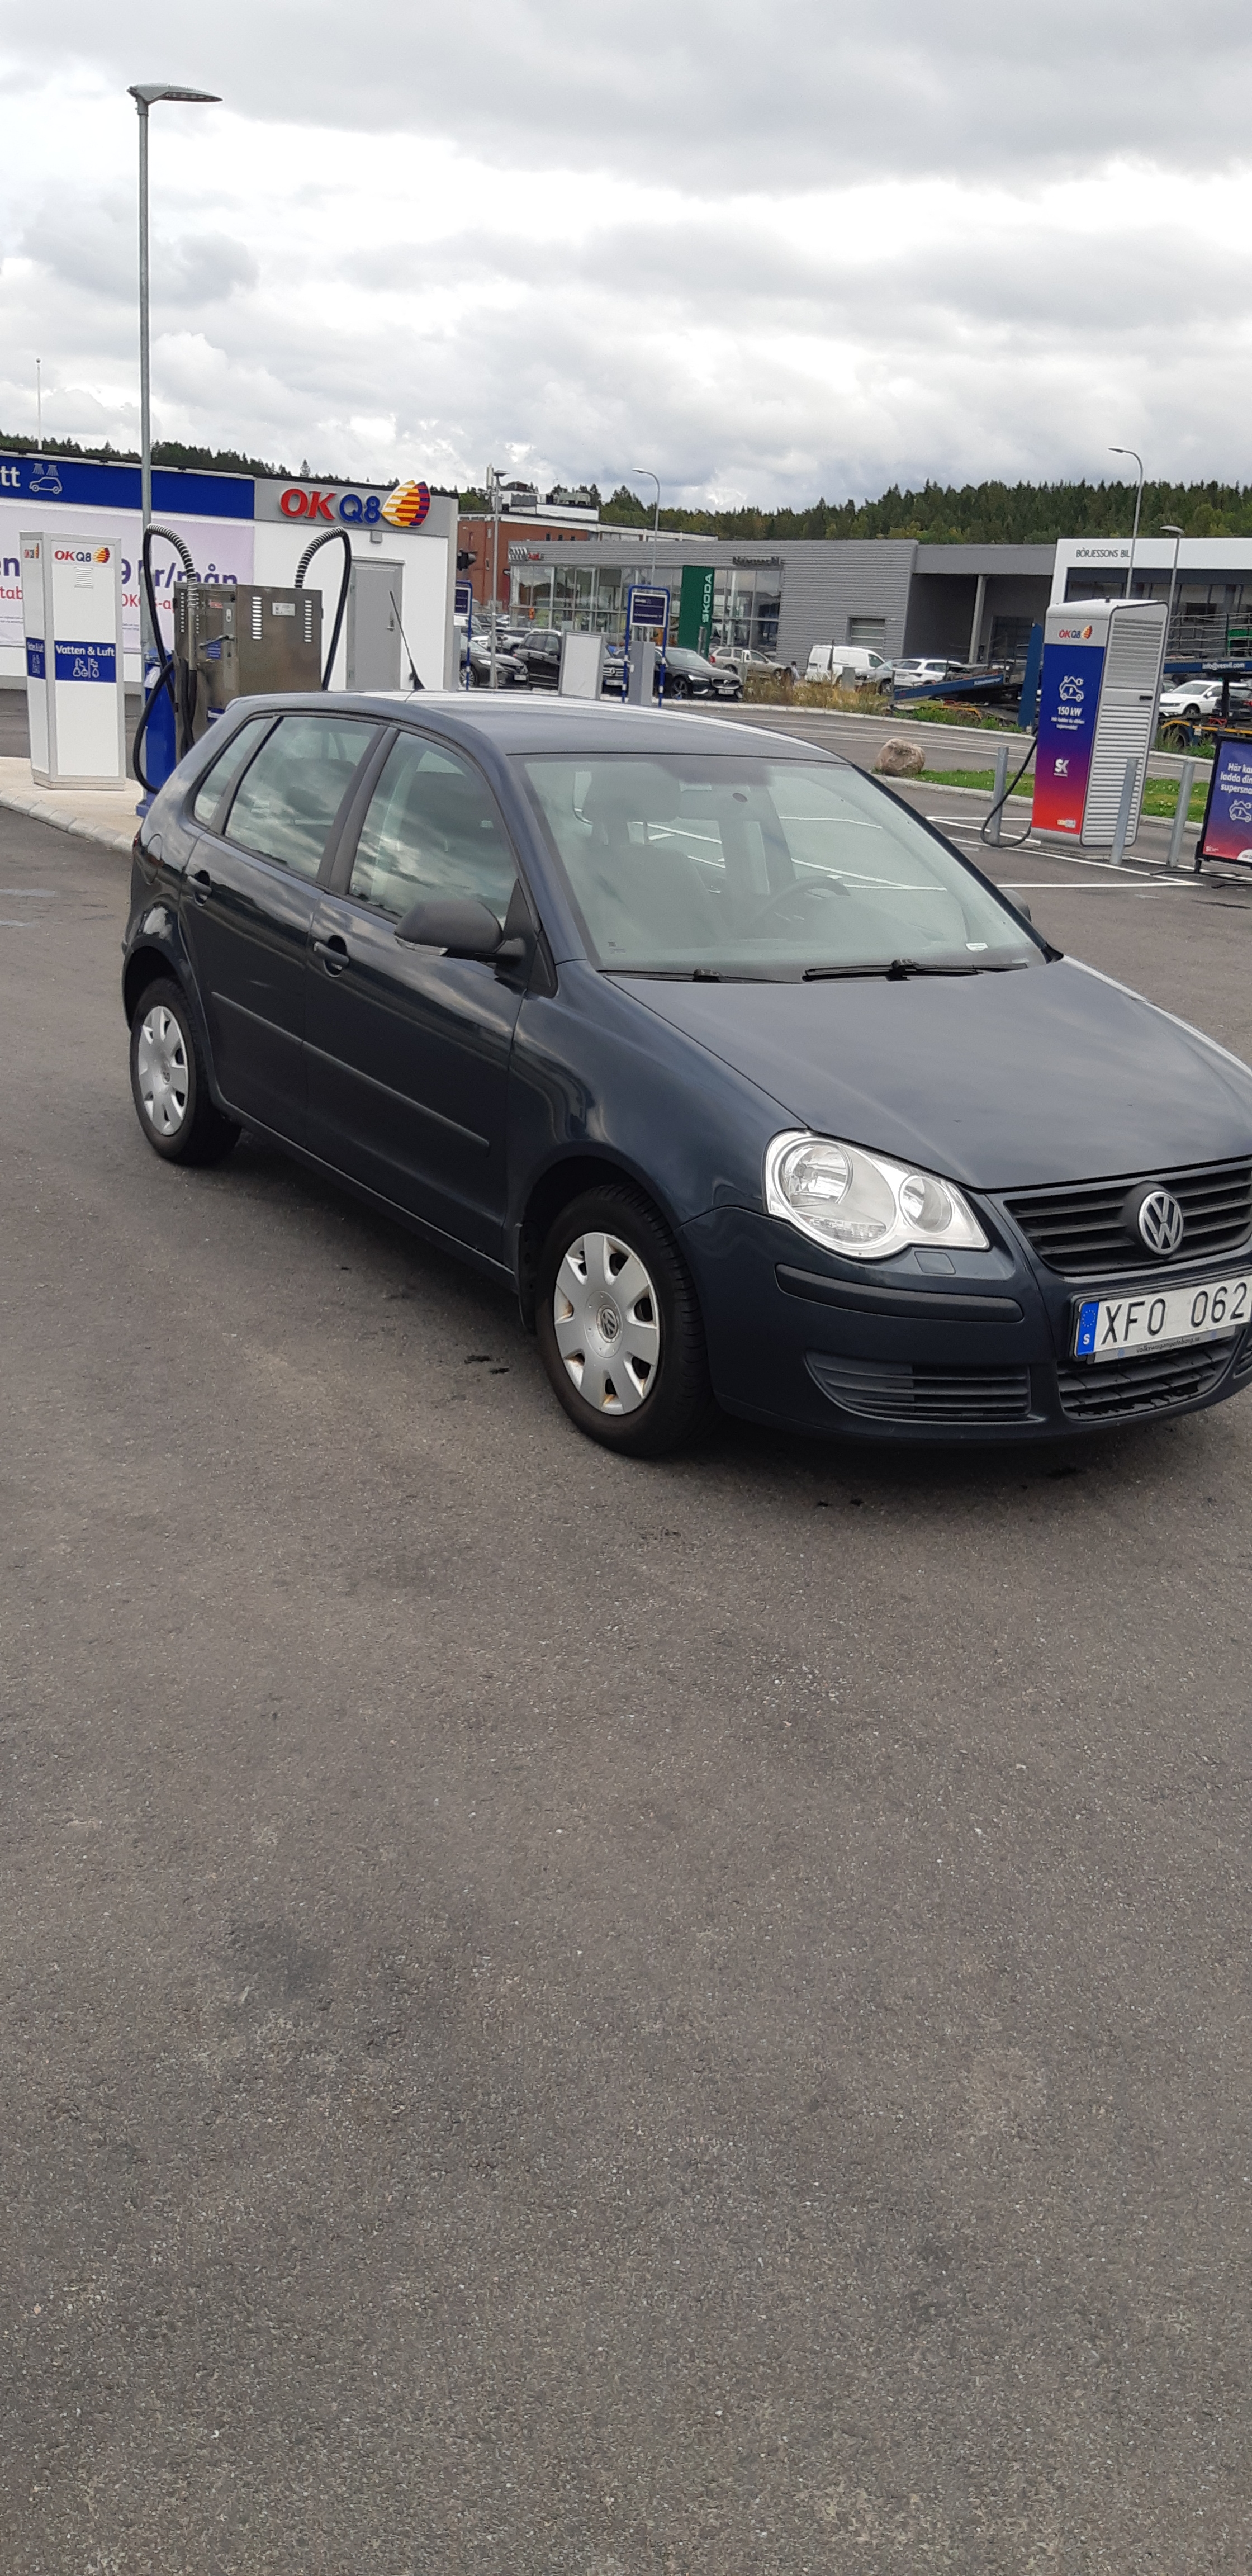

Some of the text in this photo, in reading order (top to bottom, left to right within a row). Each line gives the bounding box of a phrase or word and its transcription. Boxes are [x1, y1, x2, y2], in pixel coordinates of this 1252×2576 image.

[281, 488, 381, 524] OKQ8
[54, 550, 92, 562] OKQ8
[1076, 547, 1131, 557] BÖRJESSONS BIL
[1059, 629, 1082, 639] OKQ8
[56, 645, 115, 657] Vatten & Luft
[1057, 706, 1083, 717] 150 kW
[1227, 763, 1241, 772] Här
[1220, 771, 1241, 783] ladda
[1101, 1282, 1248, 1345] XFO 062
[1083, 1333, 1090, 1345] S
